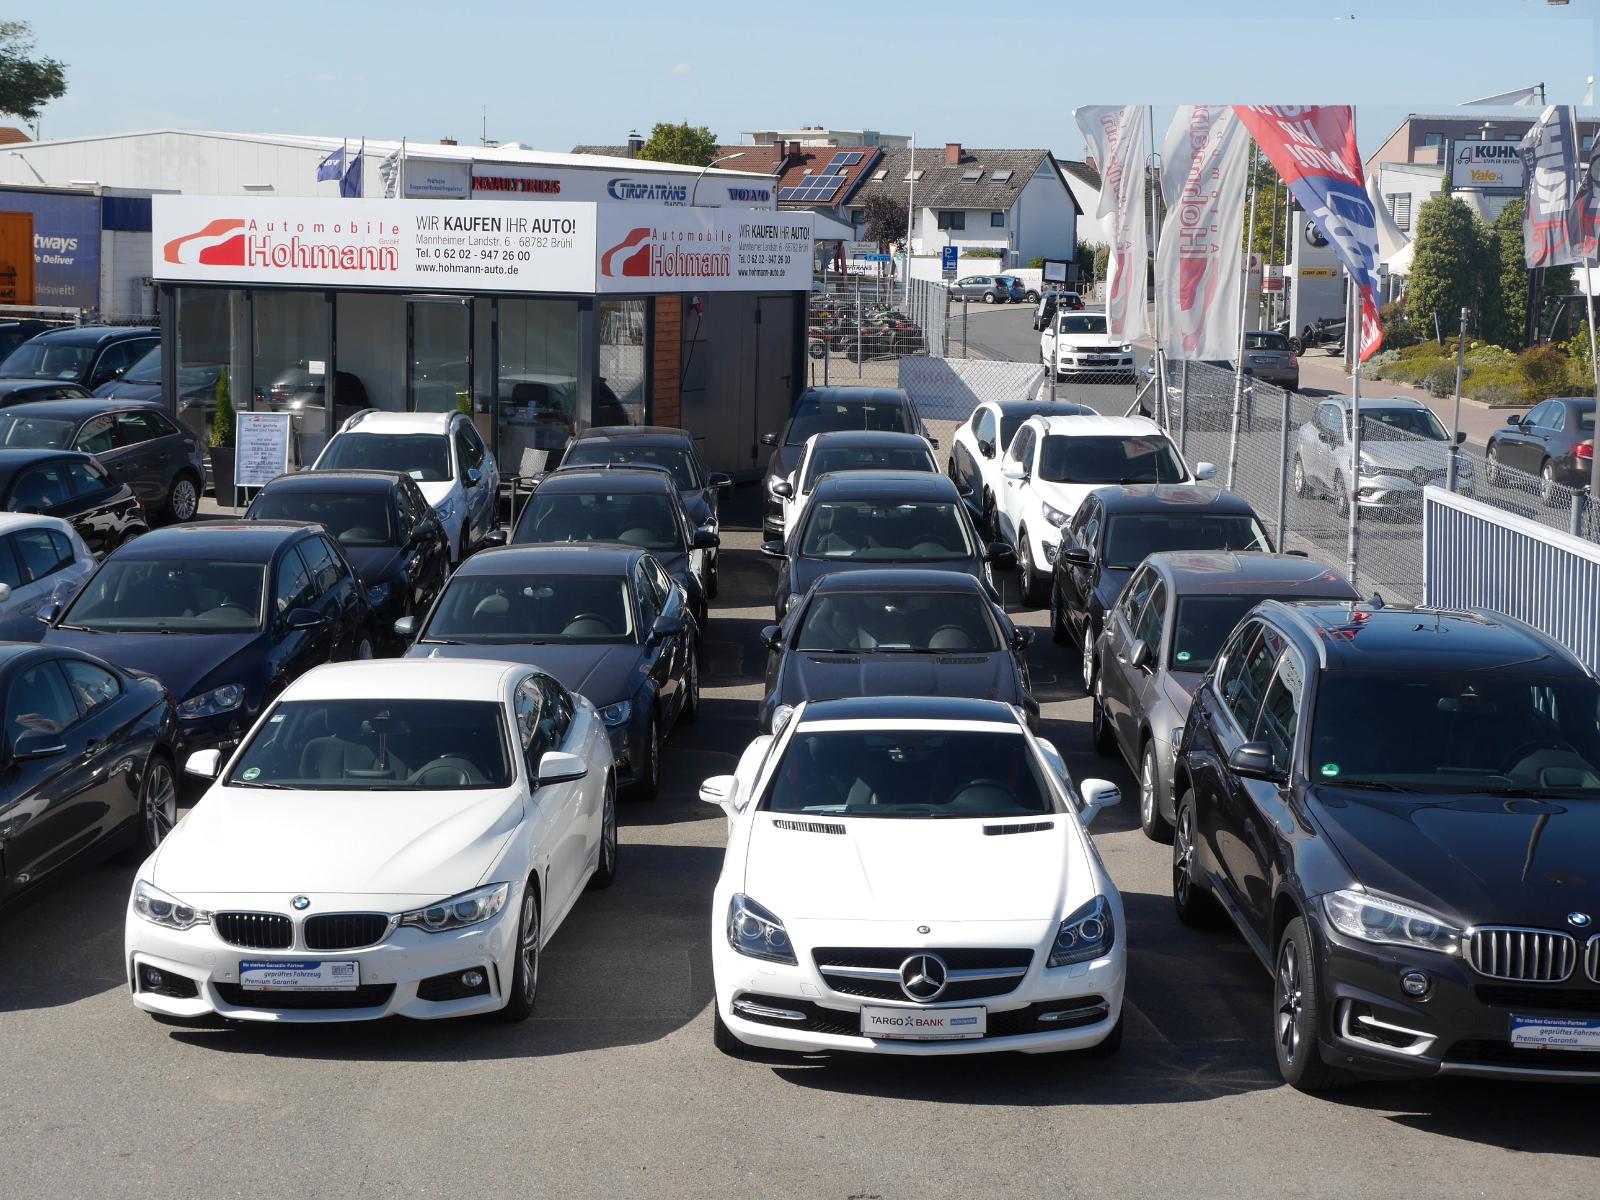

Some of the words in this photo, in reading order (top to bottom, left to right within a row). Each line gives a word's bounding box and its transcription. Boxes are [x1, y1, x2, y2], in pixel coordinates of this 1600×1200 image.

[1475, 145, 1520, 158] KUHN
[1471, 169, 1496, 181] Yale
[727, 188, 771, 202] VOLVO
[248, 218, 399, 235] Automobile
[416, 216, 439, 231] WIR
[444, 216, 502, 232] KAUFEN
[506, 217, 527, 233] IHR
[532, 219, 576, 234] AUTO!
[738, 224, 750, 238] WIR
[751, 224, 778, 239] KAUFEN
[779, 226, 790, 239] IHR
[790, 227, 810, 240] AUTO!
[415, 234, 465, 246] Mannheimer
[468, 235, 502, 246] Landstr.
[504, 236, 511, 246] 6
[519, 237, 548, 248] 68782
[651, 227, 733, 242] Automobile
[34, 233, 78, 253] tways
[43, 254, 74, 265] Deliver
[248, 234, 399, 271] Hohmann
[415, 248, 431, 259] Tel.
[434, 248, 441, 259] 0
[443, 249, 456, 259] 62
[458, 249, 471, 259] 02
[480, 250, 499, 260] 947
[502, 250, 515, 261] 26
[517, 251, 531, 261] 00
[651, 244, 731, 277] Hohmann
[415, 263, 519, 275] www.hohmann-auto.de
[35, 282, 75, 296] desweit!
[264, 971, 292, 979] geprüftes
[293, 971, 321, 979] Fahrzeug
[871, 1016, 904, 1026] TARGO
[916, 1018, 944, 1027] BANK
[1516, 1034, 1547, 1043] Premium
[1548, 1036, 1578, 1044] Garantie
[1539, 1028, 1572, 1036] geprüftes
[1573, 1029, 1600, 1037] Fahrzeu
